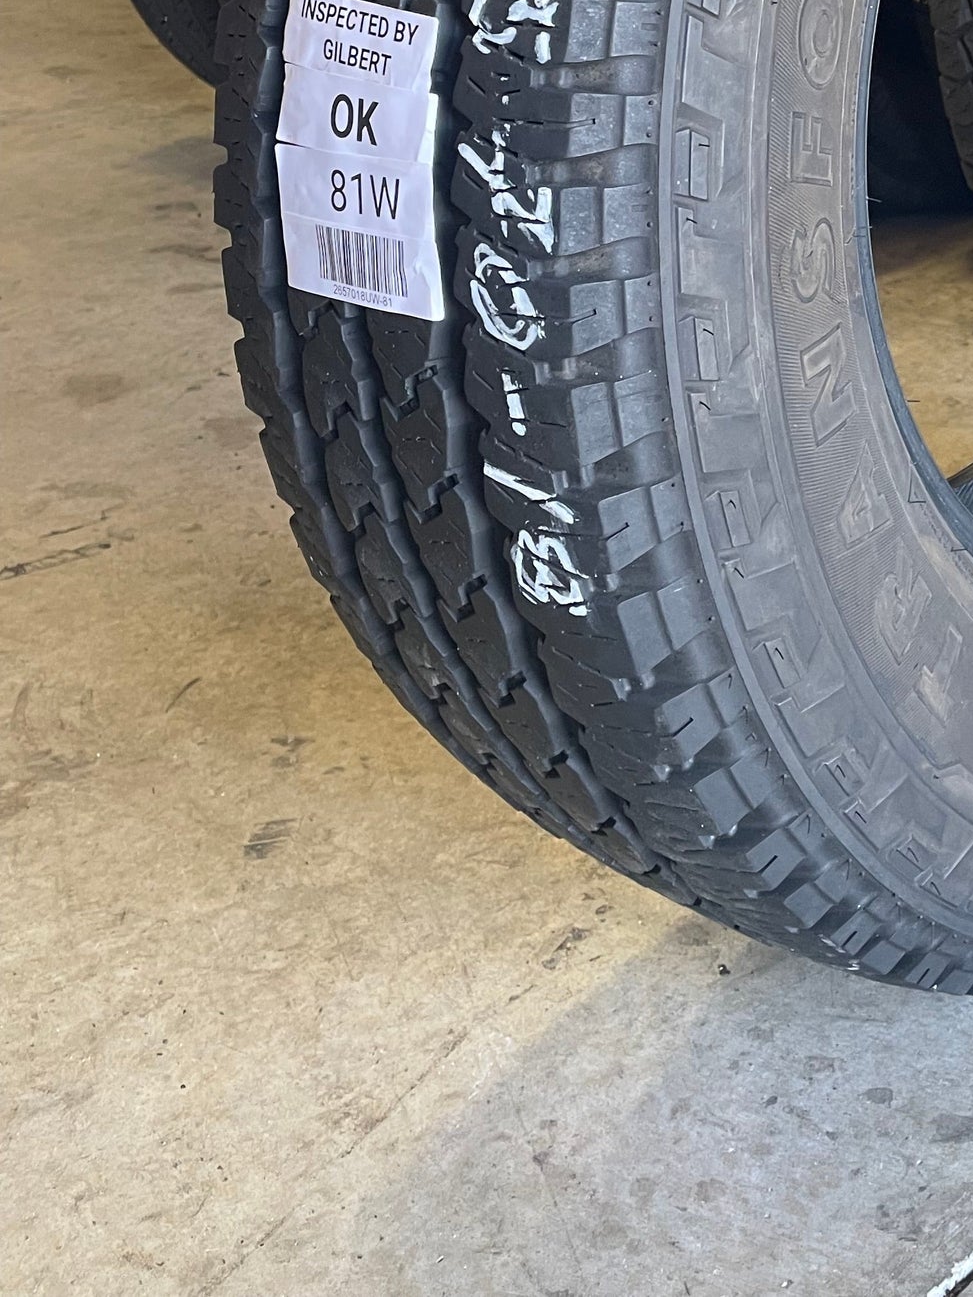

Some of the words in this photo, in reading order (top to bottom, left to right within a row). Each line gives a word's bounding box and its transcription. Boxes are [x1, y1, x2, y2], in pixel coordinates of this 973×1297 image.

[393, 20, 419, 46] BY
[323, 39, 392, 76] GILBERT
[330, 93, 379, 147] OK
[330, 169, 400, 220] 81W
